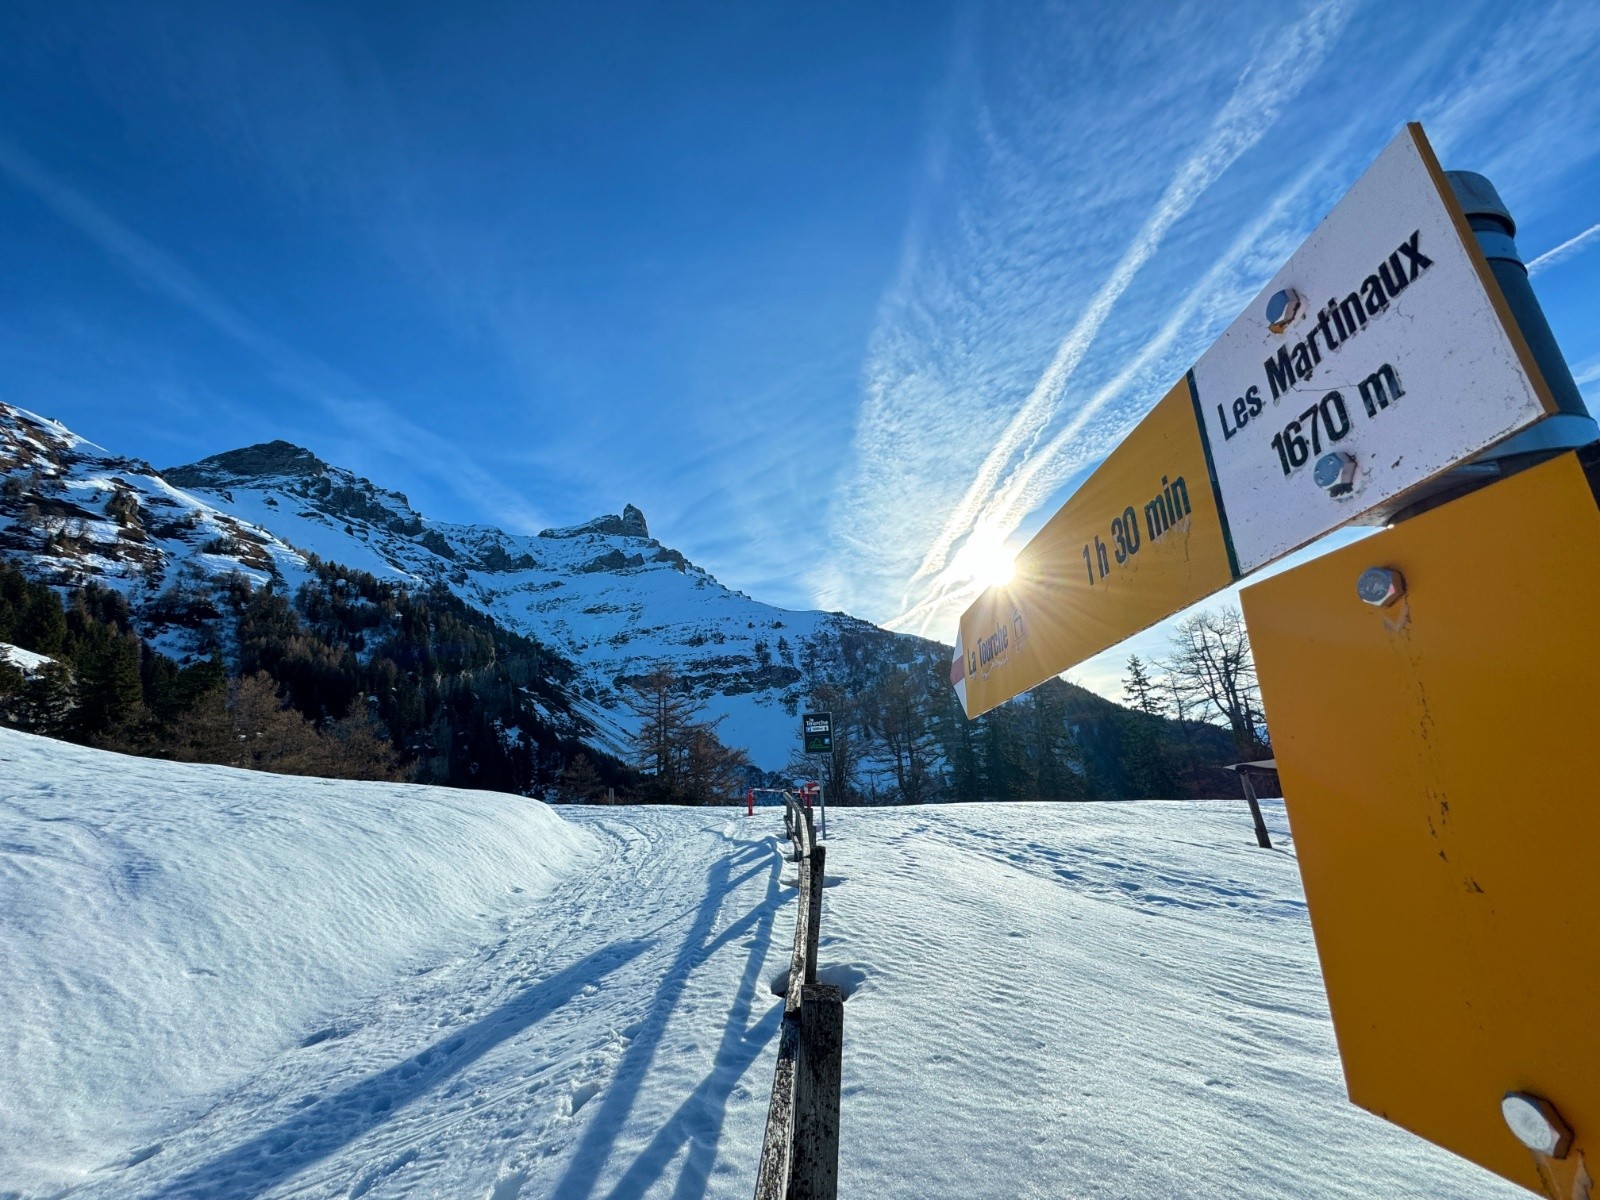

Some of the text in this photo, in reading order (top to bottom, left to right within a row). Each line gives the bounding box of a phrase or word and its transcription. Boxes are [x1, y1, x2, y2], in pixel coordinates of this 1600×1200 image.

[1217, 230, 1433, 440] Les Martinaux
[1271, 363, 1405, 475] 1670 m
[1083, 475, 1191, 586] 1 h 30 min
[967, 622, 1008, 675] La Tourche
